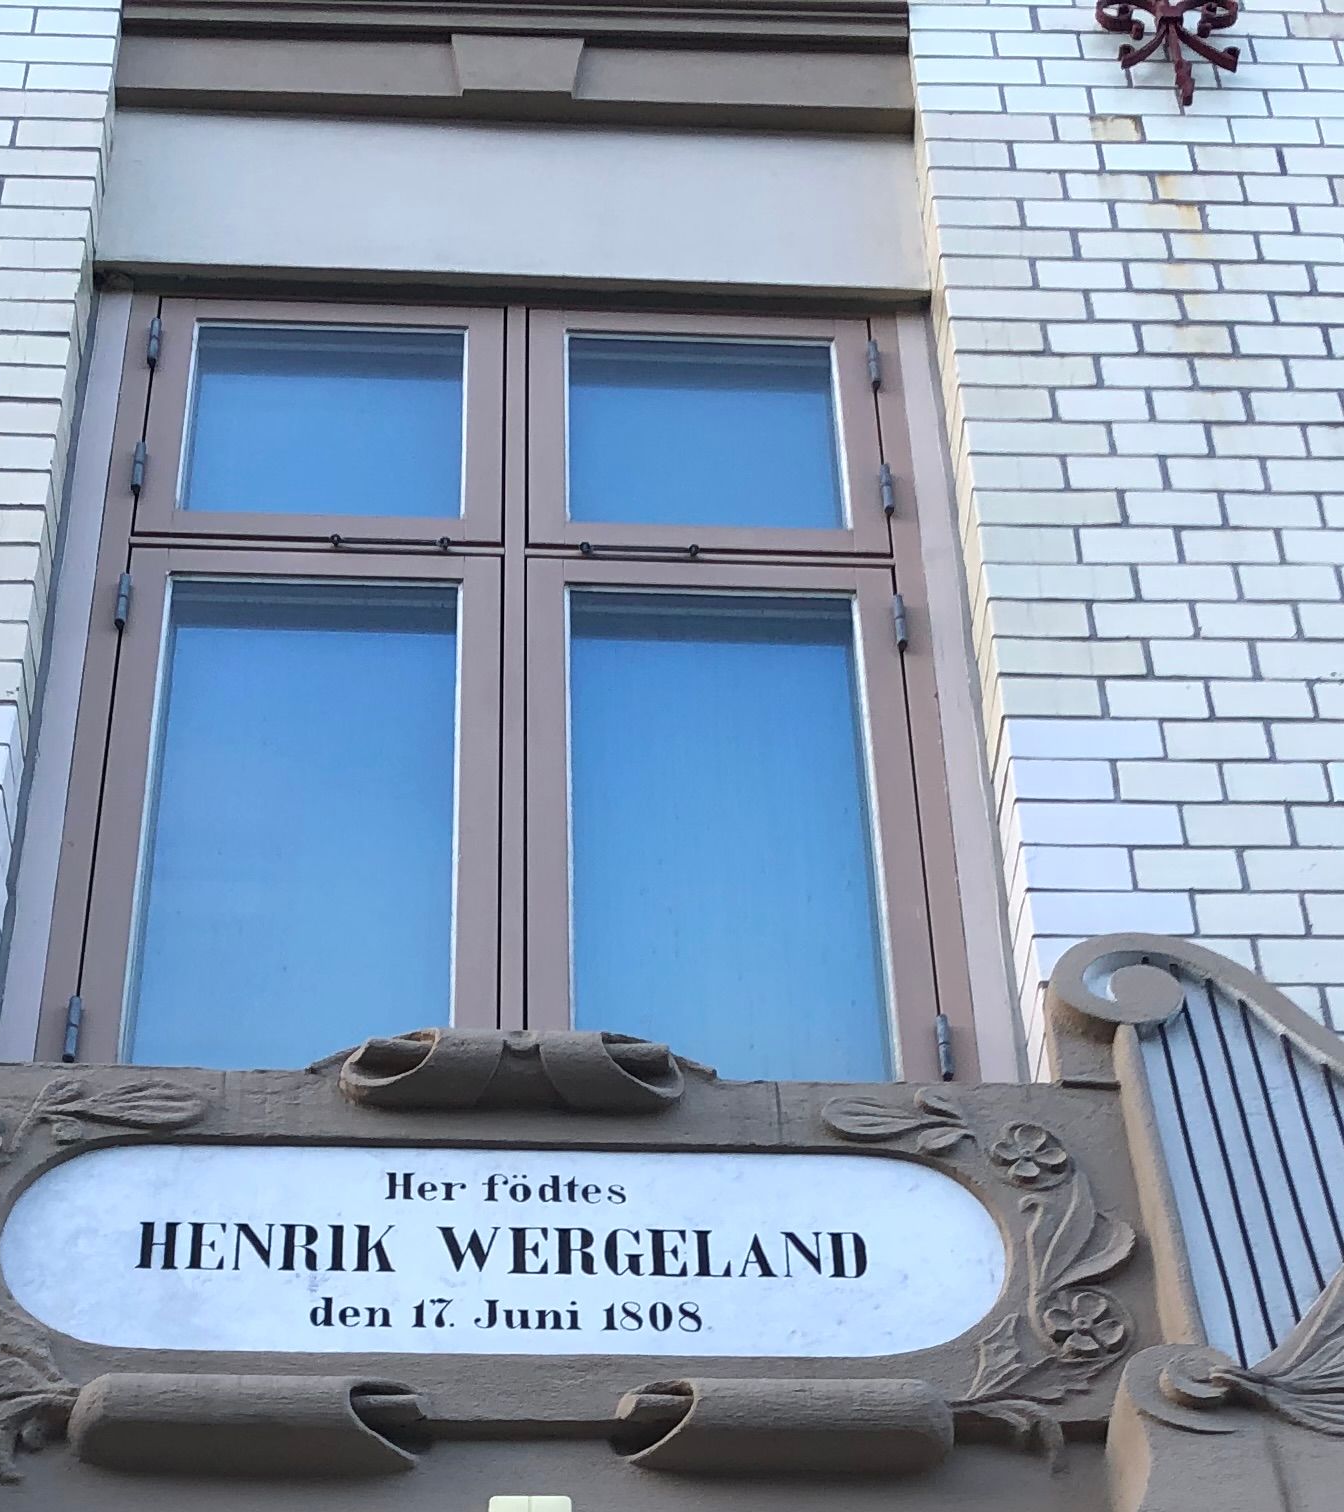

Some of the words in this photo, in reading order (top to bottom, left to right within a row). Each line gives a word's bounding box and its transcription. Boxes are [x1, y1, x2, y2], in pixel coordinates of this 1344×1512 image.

[385, 1172, 468, 1202] Her
[484, 1173, 627, 1204] födtes
[134, 1221, 396, 1273] HENRIK
[437, 1226, 868, 1279] WERGELAND
[309, 1296, 392, 1328] den
[412, 1297, 455, 1328] 17.
[474, 1299, 581, 1330] Juni
